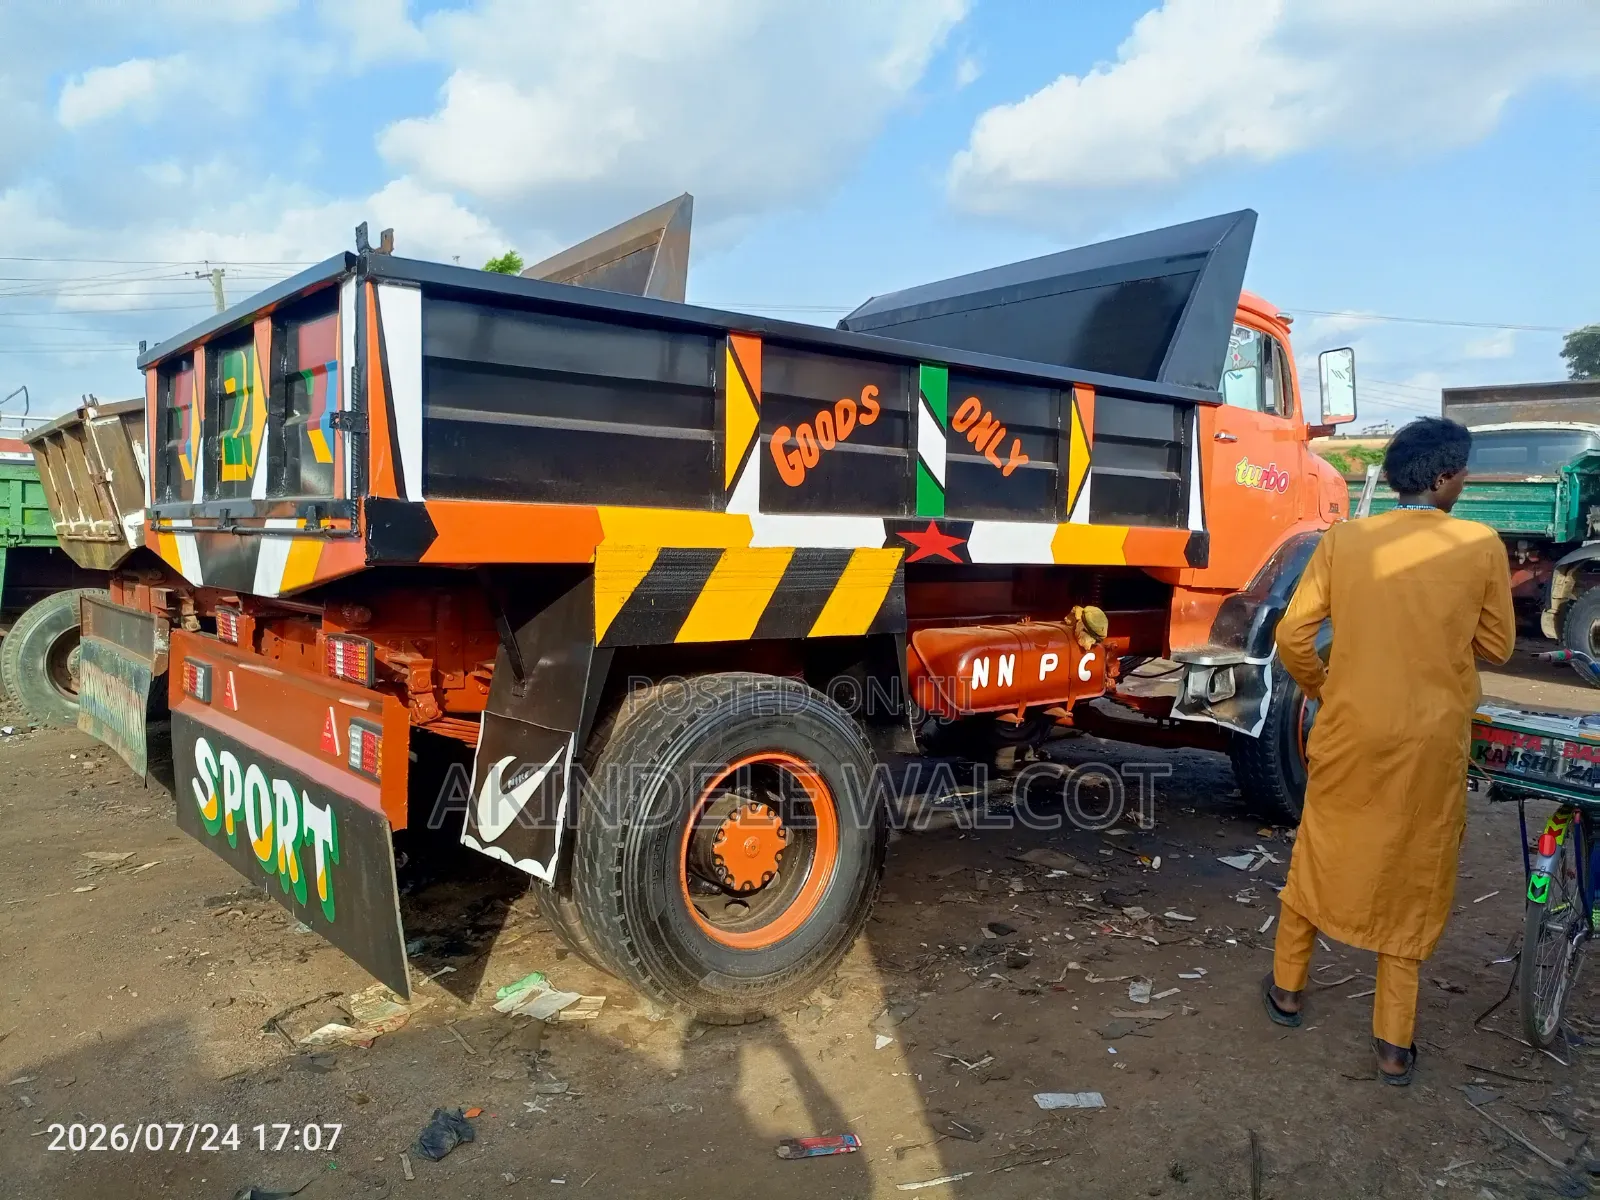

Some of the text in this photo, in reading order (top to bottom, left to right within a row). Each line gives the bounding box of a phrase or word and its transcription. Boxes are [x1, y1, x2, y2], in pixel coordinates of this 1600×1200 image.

[770, 385, 1029, 487] GOODS ONLY
[1236, 456, 1290, 494] turbo
[192, 737, 339, 923] SPORT
